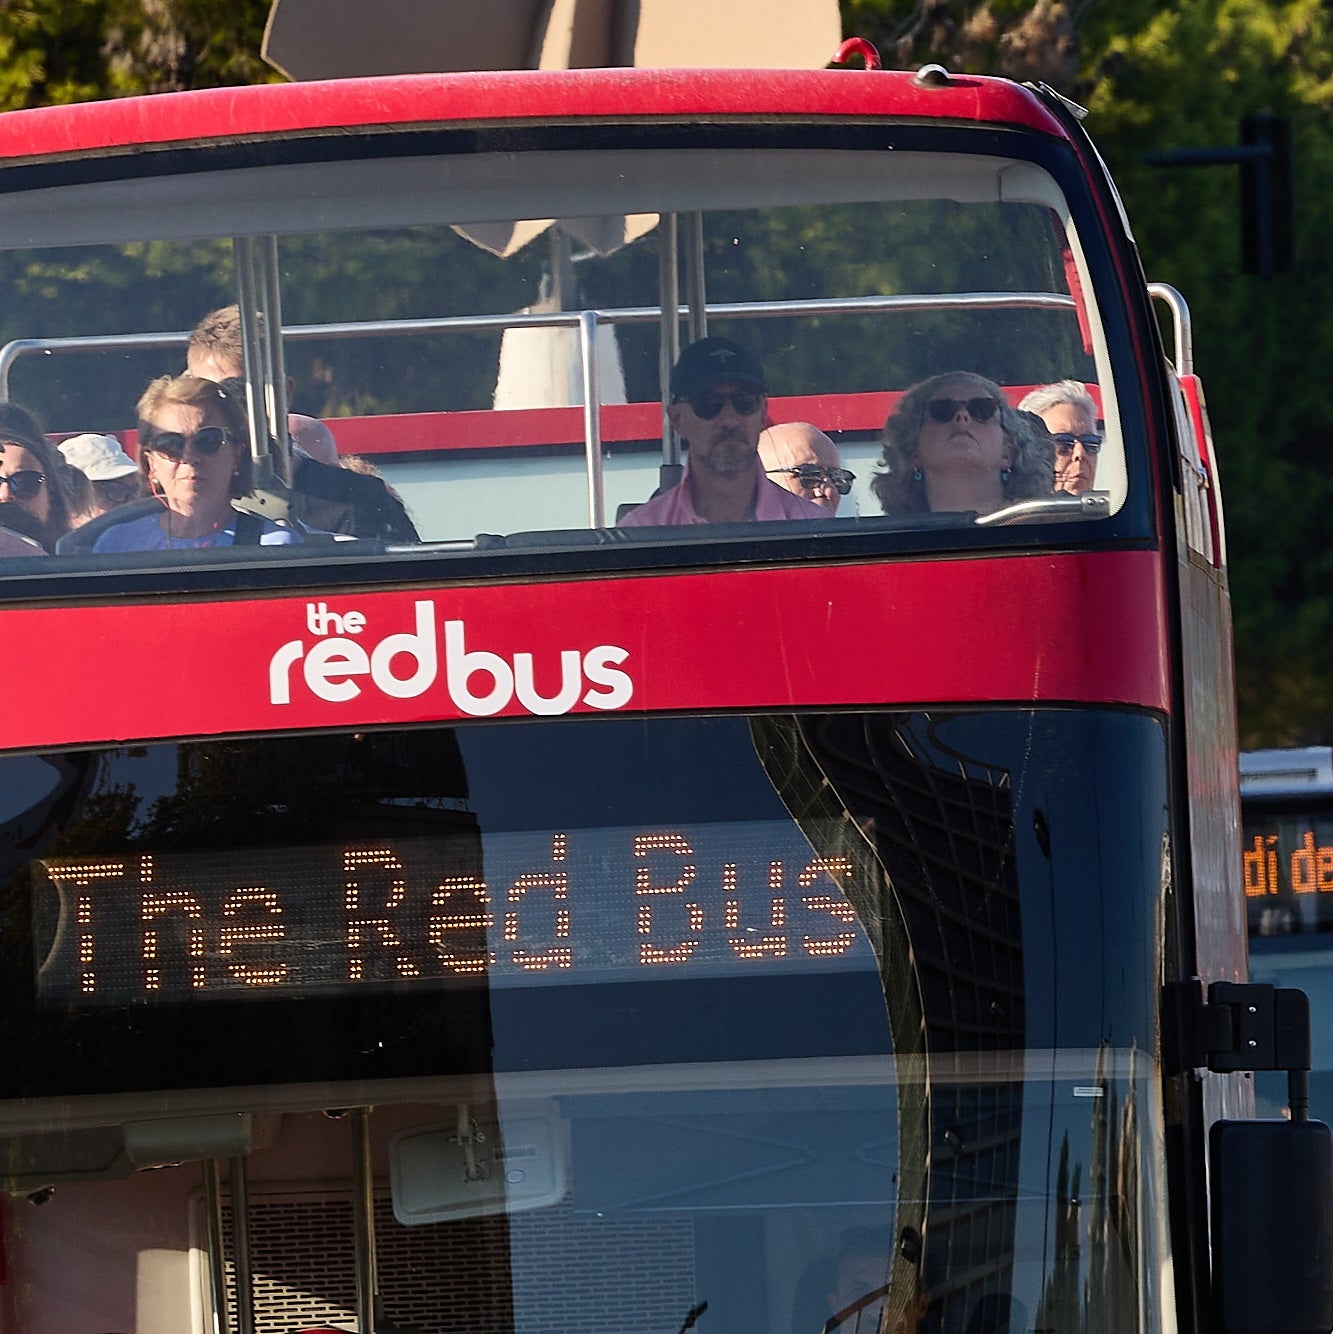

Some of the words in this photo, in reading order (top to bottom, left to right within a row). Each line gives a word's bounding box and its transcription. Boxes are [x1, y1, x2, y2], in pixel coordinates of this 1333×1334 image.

[306, 602, 367, 636] the
[46, 854, 288, 993] The
[342, 832, 574, 981] Red
[632, 832, 857, 966] Bus
